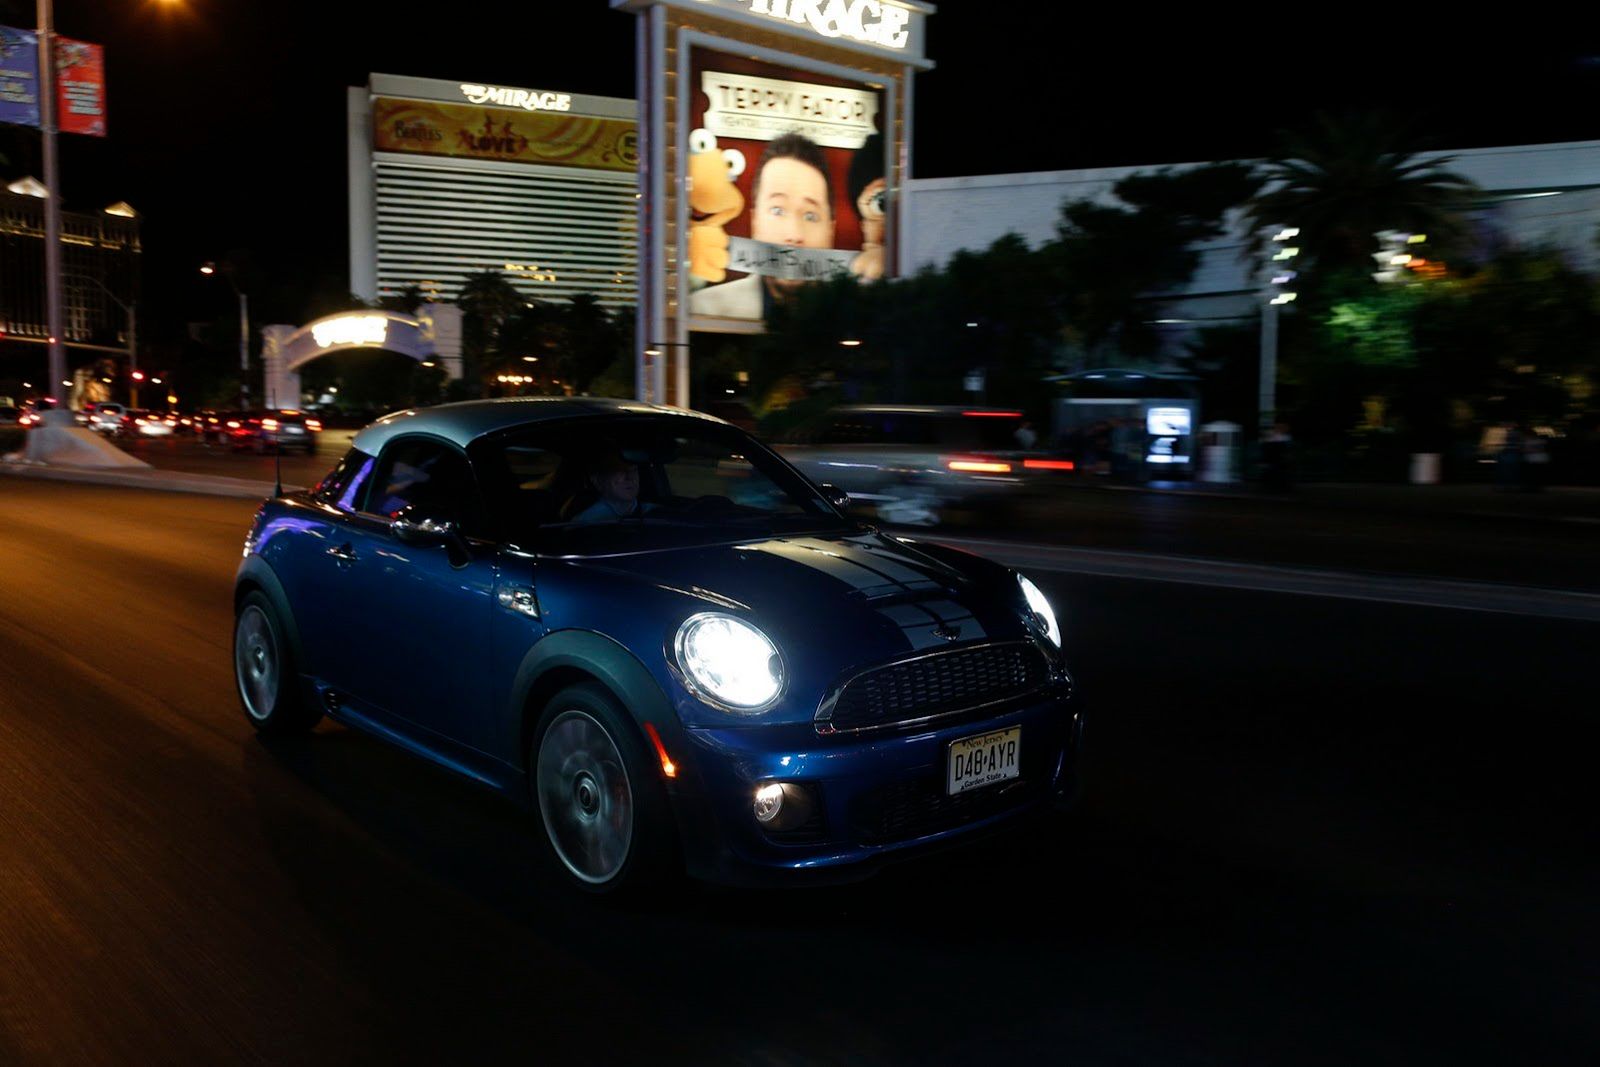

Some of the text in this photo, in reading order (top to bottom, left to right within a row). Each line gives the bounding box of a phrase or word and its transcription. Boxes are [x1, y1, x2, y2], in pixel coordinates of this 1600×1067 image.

[735, 0, 909, 48] RAGE
[488, 87, 571, 111] MIRAGE
[967, 735, 1004, 749] New Jersey
[964, 774, 1002, 788] Garden State
